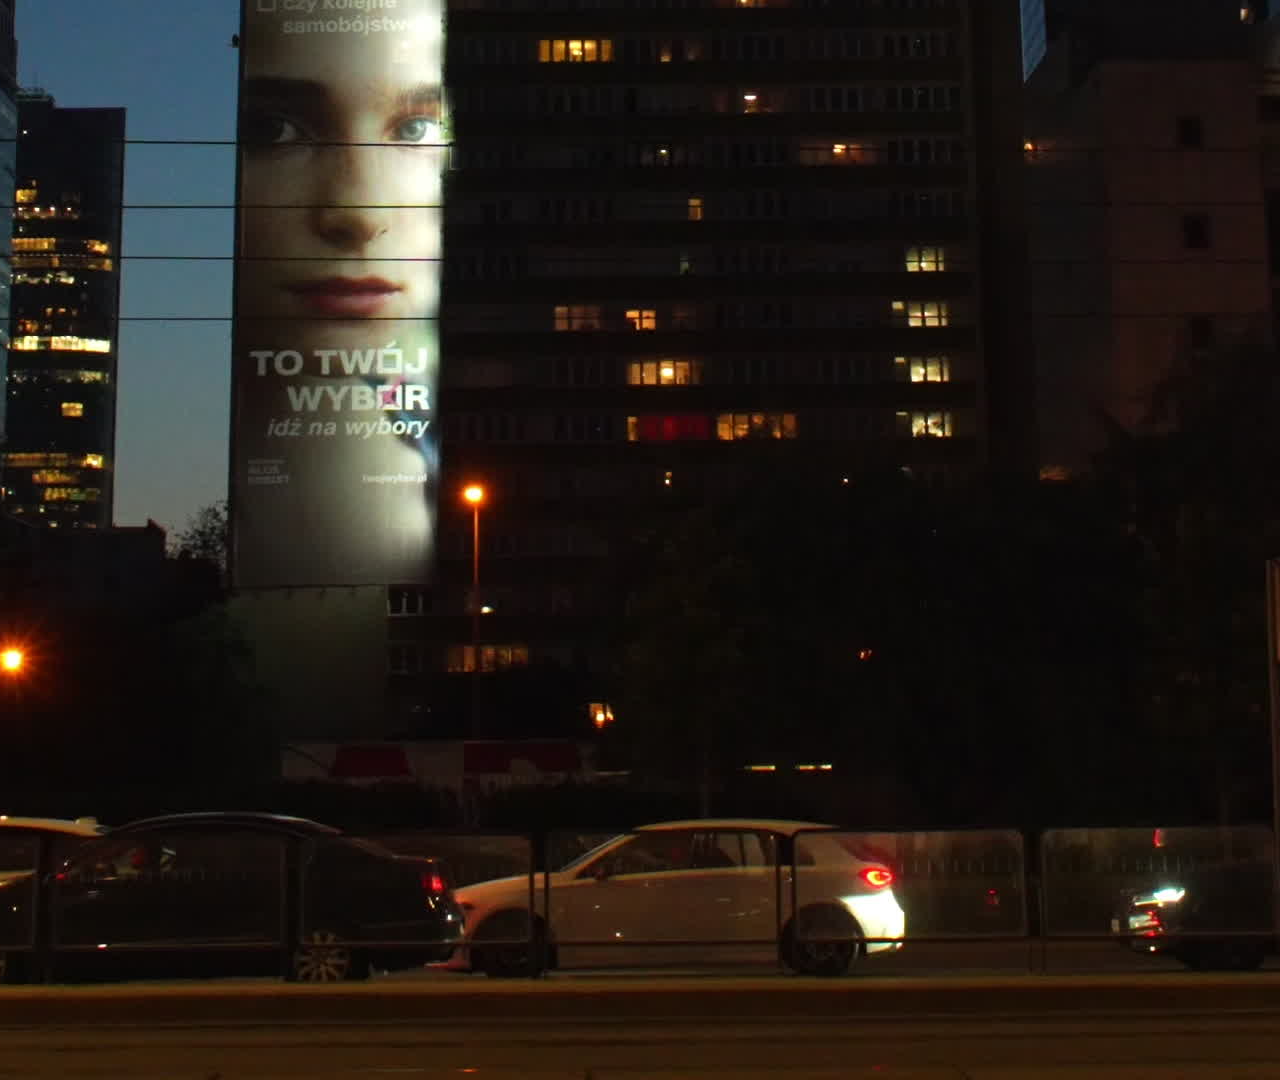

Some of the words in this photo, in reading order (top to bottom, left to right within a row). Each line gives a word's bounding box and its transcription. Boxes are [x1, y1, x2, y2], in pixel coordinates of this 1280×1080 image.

[282, 16, 420, 37] samobójstw
[250, 350, 304, 376] TO
[314, 341, 428, 375] TWÓJ
[287, 376, 430, 412] WYBÓR
[308, 422, 337, 436] na
[345, 418, 430, 439] wybory
